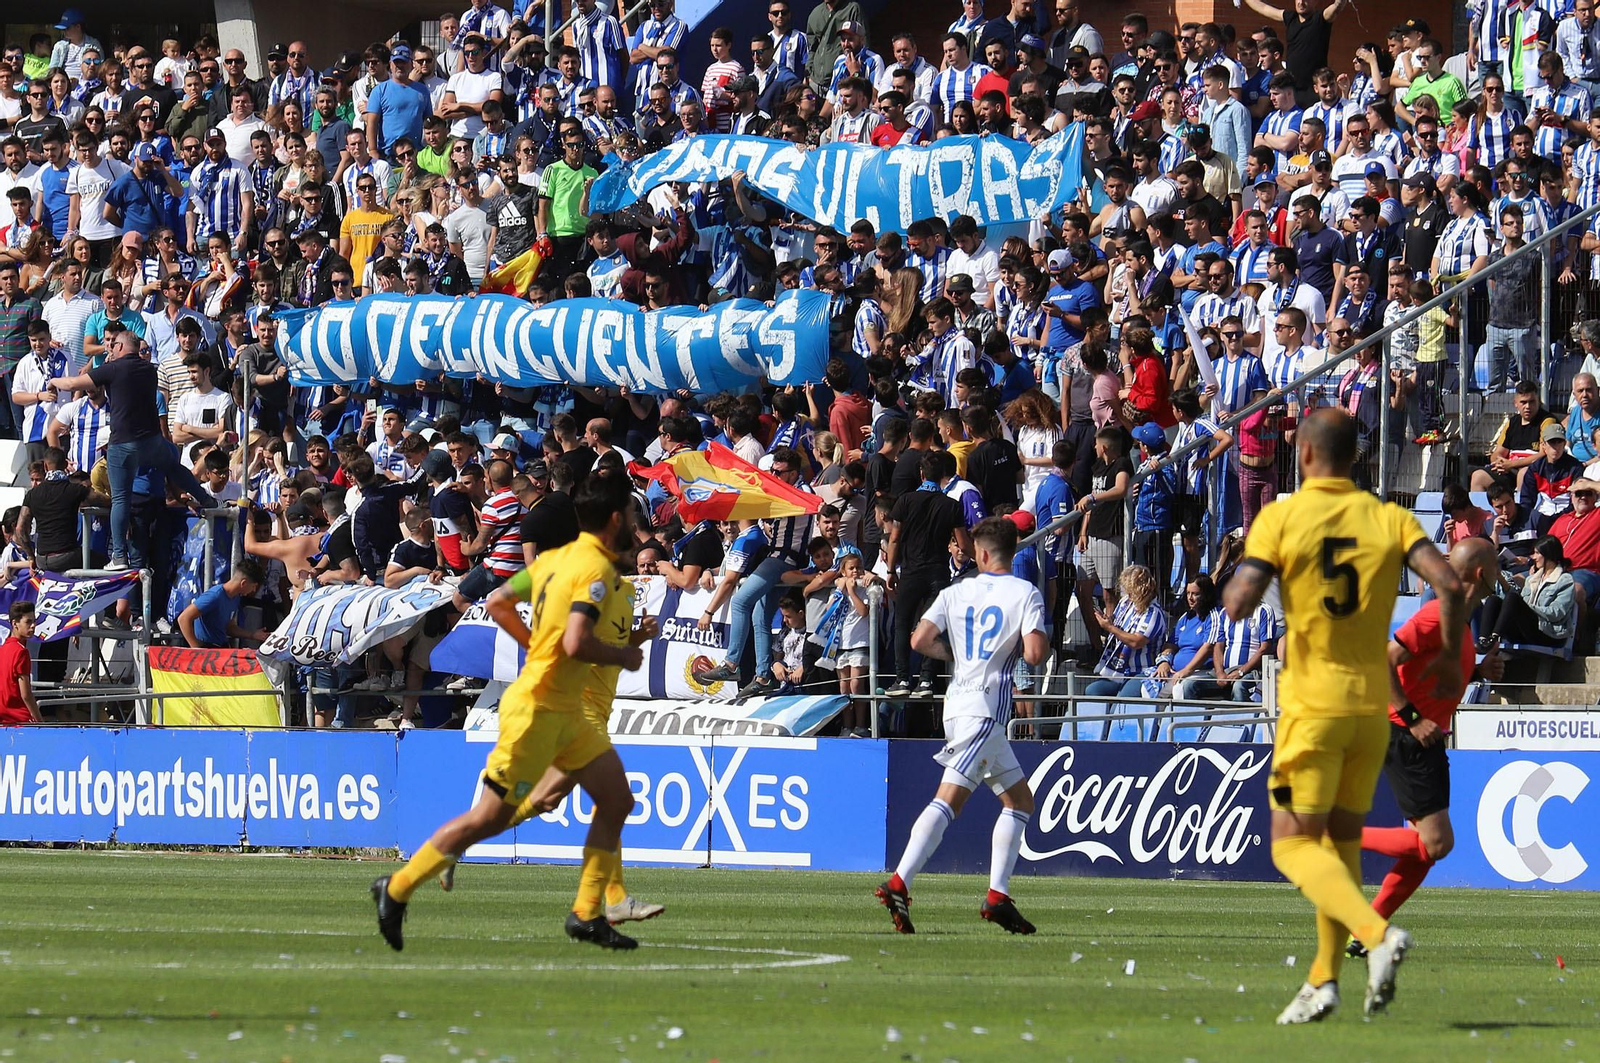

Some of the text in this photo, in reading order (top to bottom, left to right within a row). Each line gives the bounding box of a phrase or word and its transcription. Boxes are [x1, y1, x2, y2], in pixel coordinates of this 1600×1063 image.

[628, 127, 1070, 234] OMOS ULTRAS
[499, 216, 527, 228] adidas
[1322, 536, 1360, 619] 5
[965, 605, 1004, 661] 12
[157, 649, 257, 675] ULTRAS
[1496, 720, 1600, 739] AUTOESCUEL
[1019, 746, 1272, 865] Coca-Cola
